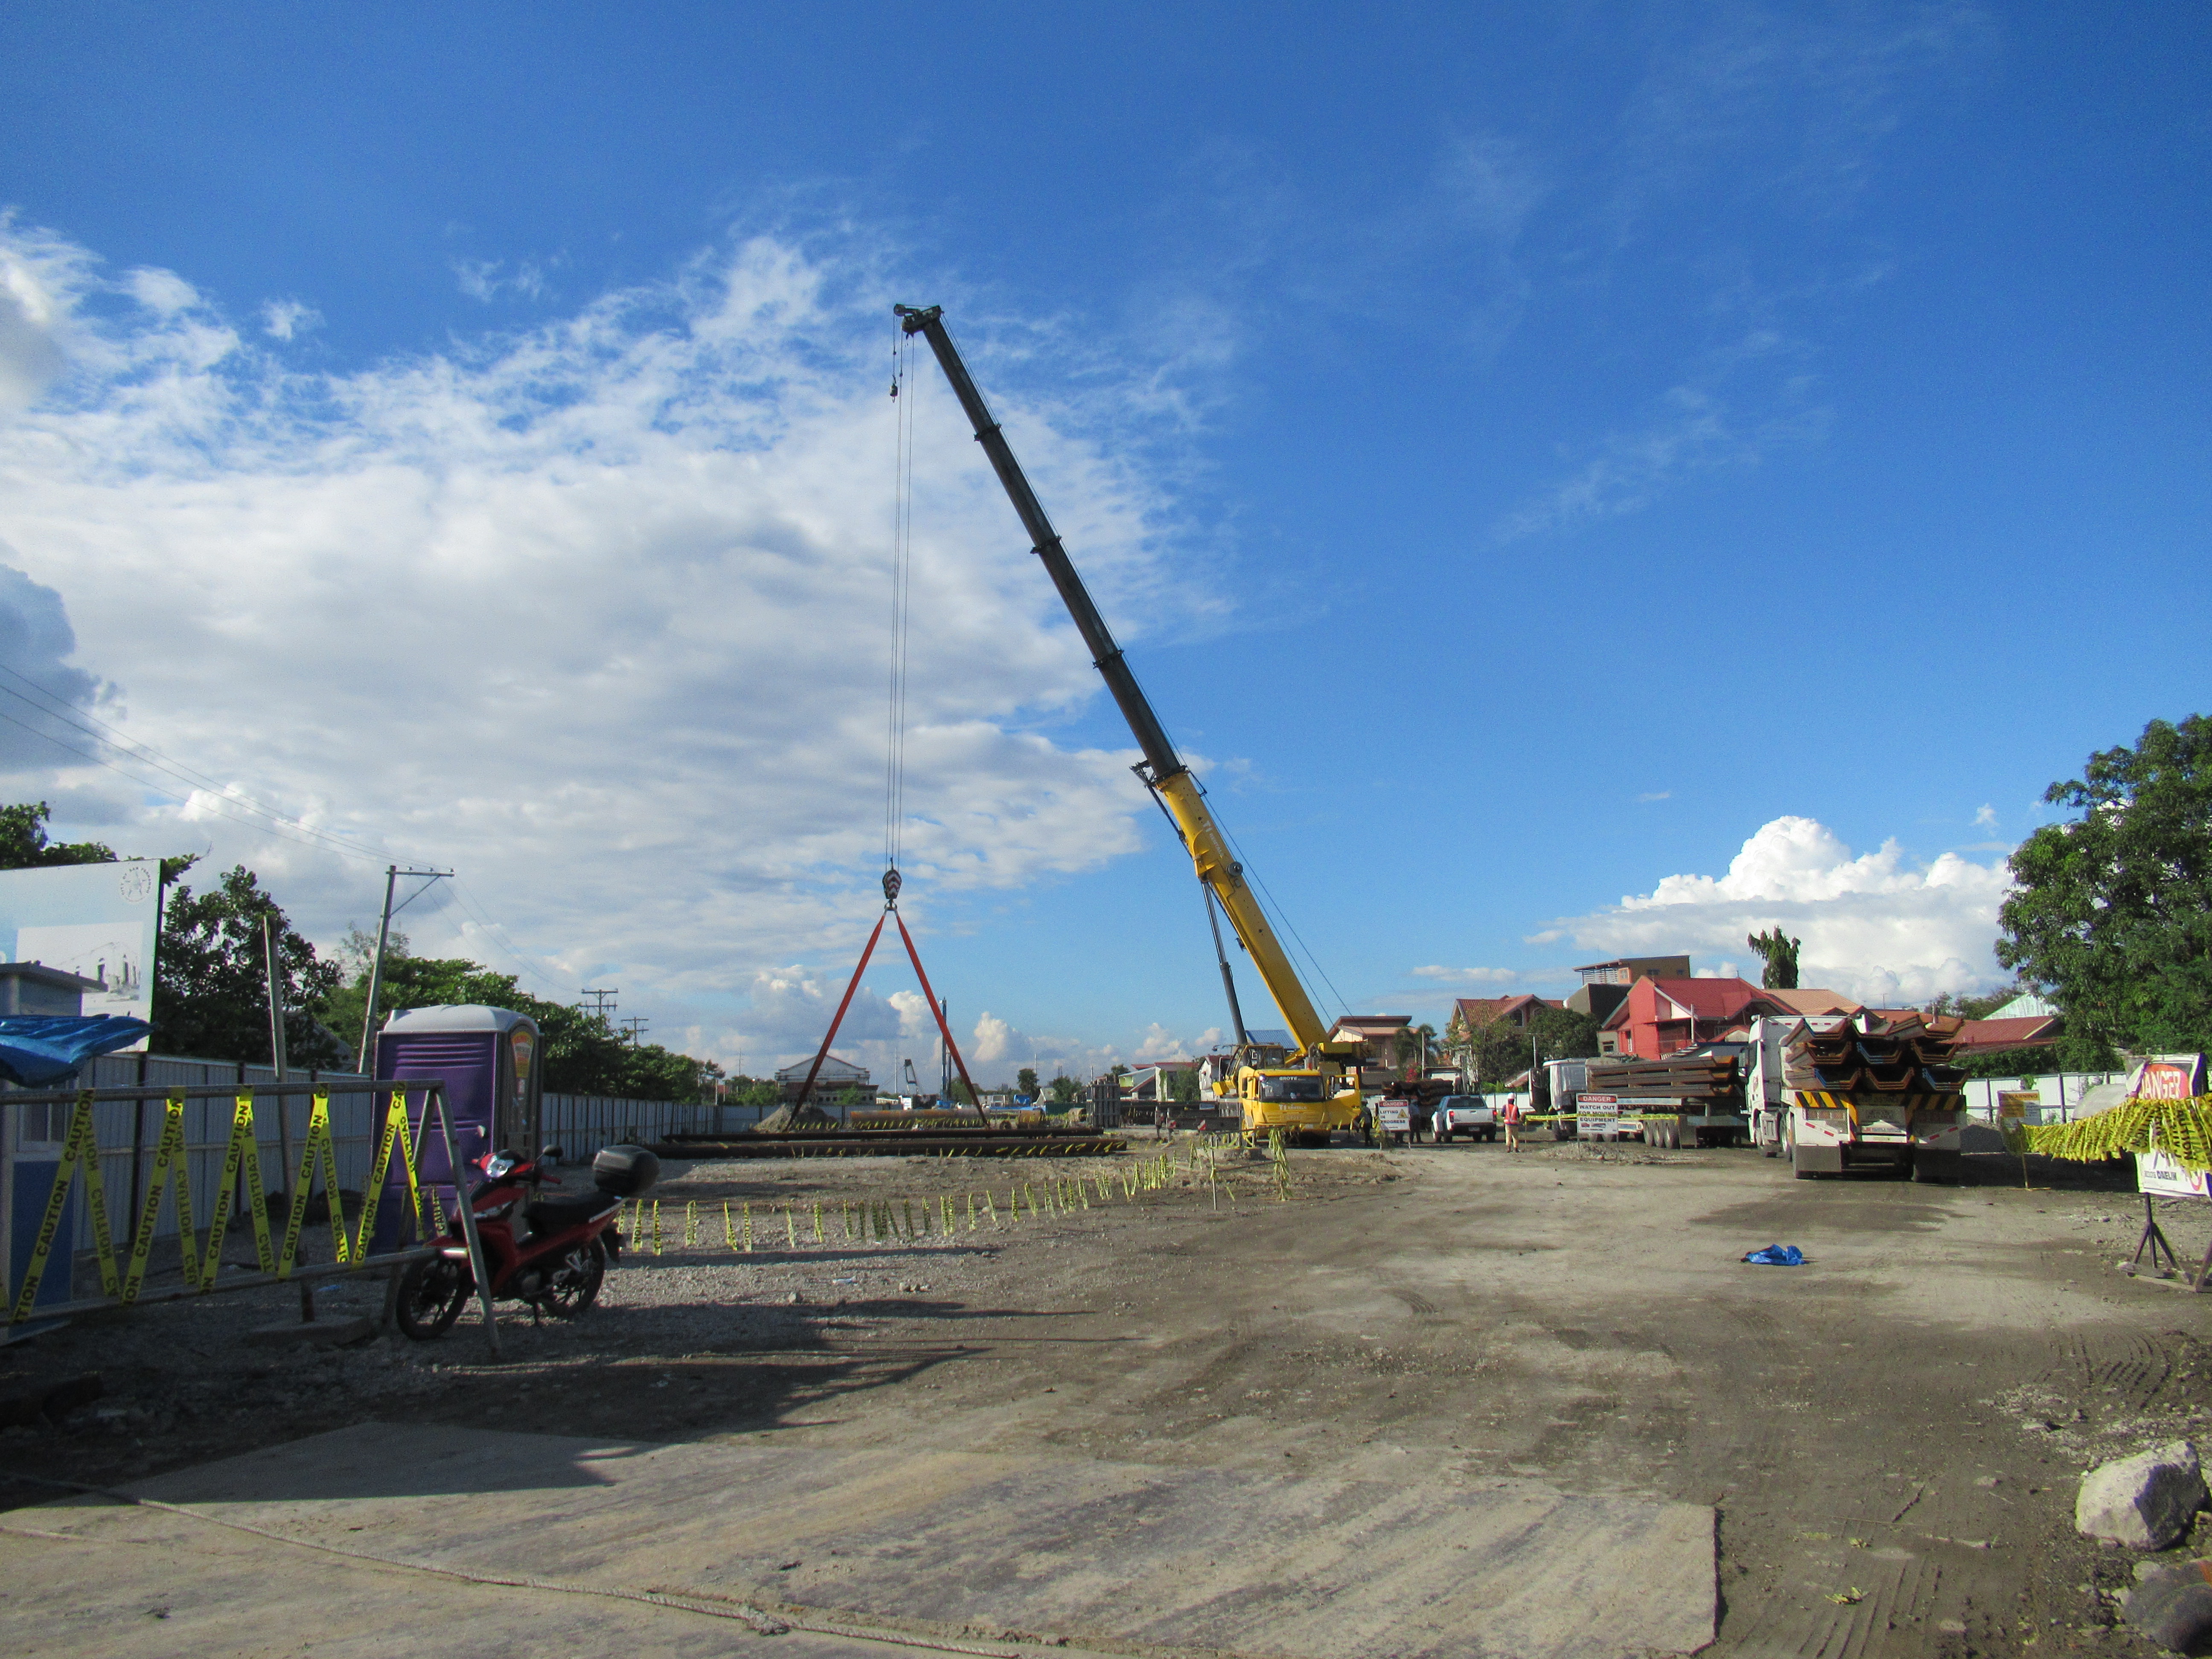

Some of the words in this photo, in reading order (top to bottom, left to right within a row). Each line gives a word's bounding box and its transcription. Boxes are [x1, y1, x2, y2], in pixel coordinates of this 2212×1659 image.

[65, 1089, 94, 1162] CAUTION
[158, 1097, 183, 1167] CAUTION
[226, 1105, 249, 1173] CAUTION
[301, 1115, 323, 1179] CAUTION
[374, 1123, 395, 1184] CAUTION
[36, 1180, 68, 1256] CAUTION
[135, 1185, 162, 1257] CAUTION
[209, 1190, 231, 1259] CAUTION
[283, 1195, 306, 1260] CAUTION
[356, 1199, 376, 1260] CAUTION
[15, 1276, 40, 1318] TION
